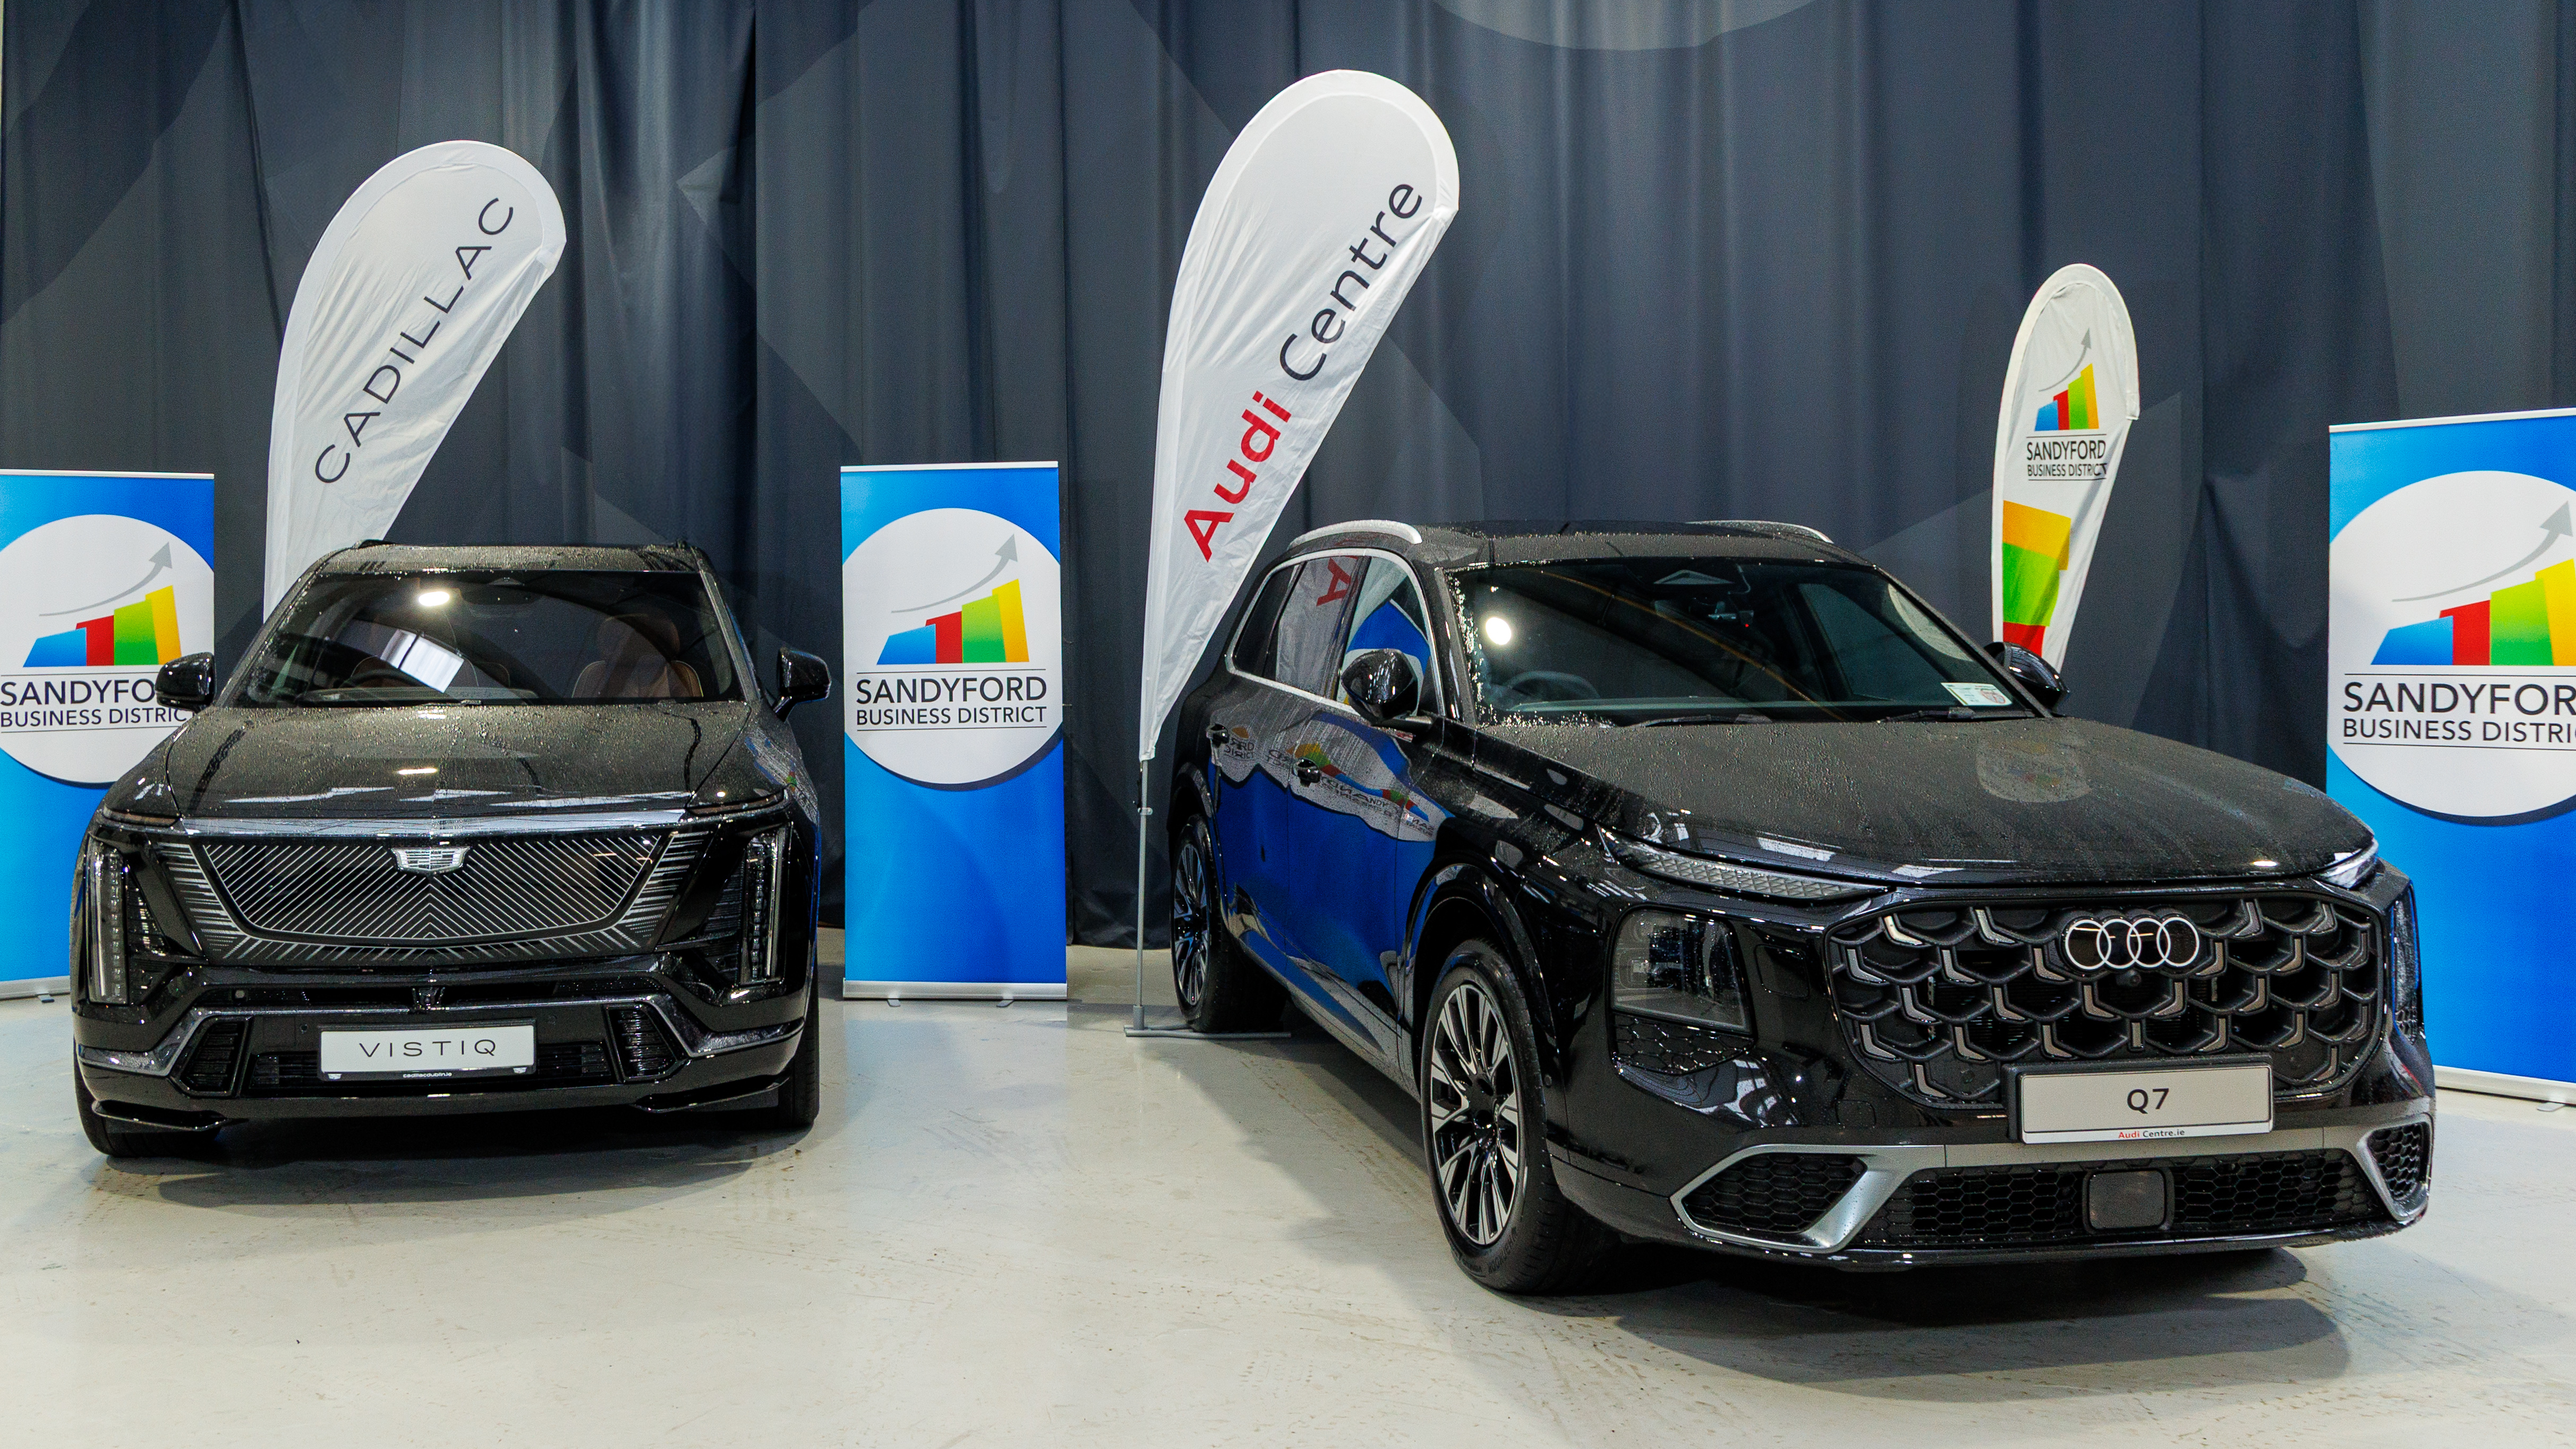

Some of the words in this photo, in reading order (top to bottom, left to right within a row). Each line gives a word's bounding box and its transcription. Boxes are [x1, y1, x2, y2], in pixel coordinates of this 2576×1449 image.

[315, 198, 514, 483] CADILLAC
[1184, 390, 1292, 562] Audi
[1280, 183, 1422, 381] Centre
[2027, 440, 2106, 461] SANDYFORD
[2027, 464, 2066, 476] BUSINESS
[2068, 463, 2107, 476] DISTRICT
[0, 678, 156, 706] SANDYFO
[856, 676, 1047, 704] SANDYFORD
[2343, 681, 2576, 715] SANDYFOR
[1, 709, 101, 727] BUSINESS
[109, 707, 196, 724] DISTRIC
[857, 708, 951, 726] BUSINESS
[958, 706, 1047, 723] DISTRICT
[2343, 718, 2471, 741] BUSINESS
[2482, 721, 2576, 744] DISTRI
[359, 1039, 496, 1058] VISTIQ
[2127, 1087, 2170, 1114] Q7
[2143, 1129, 2185, 1137] Centre.ie
